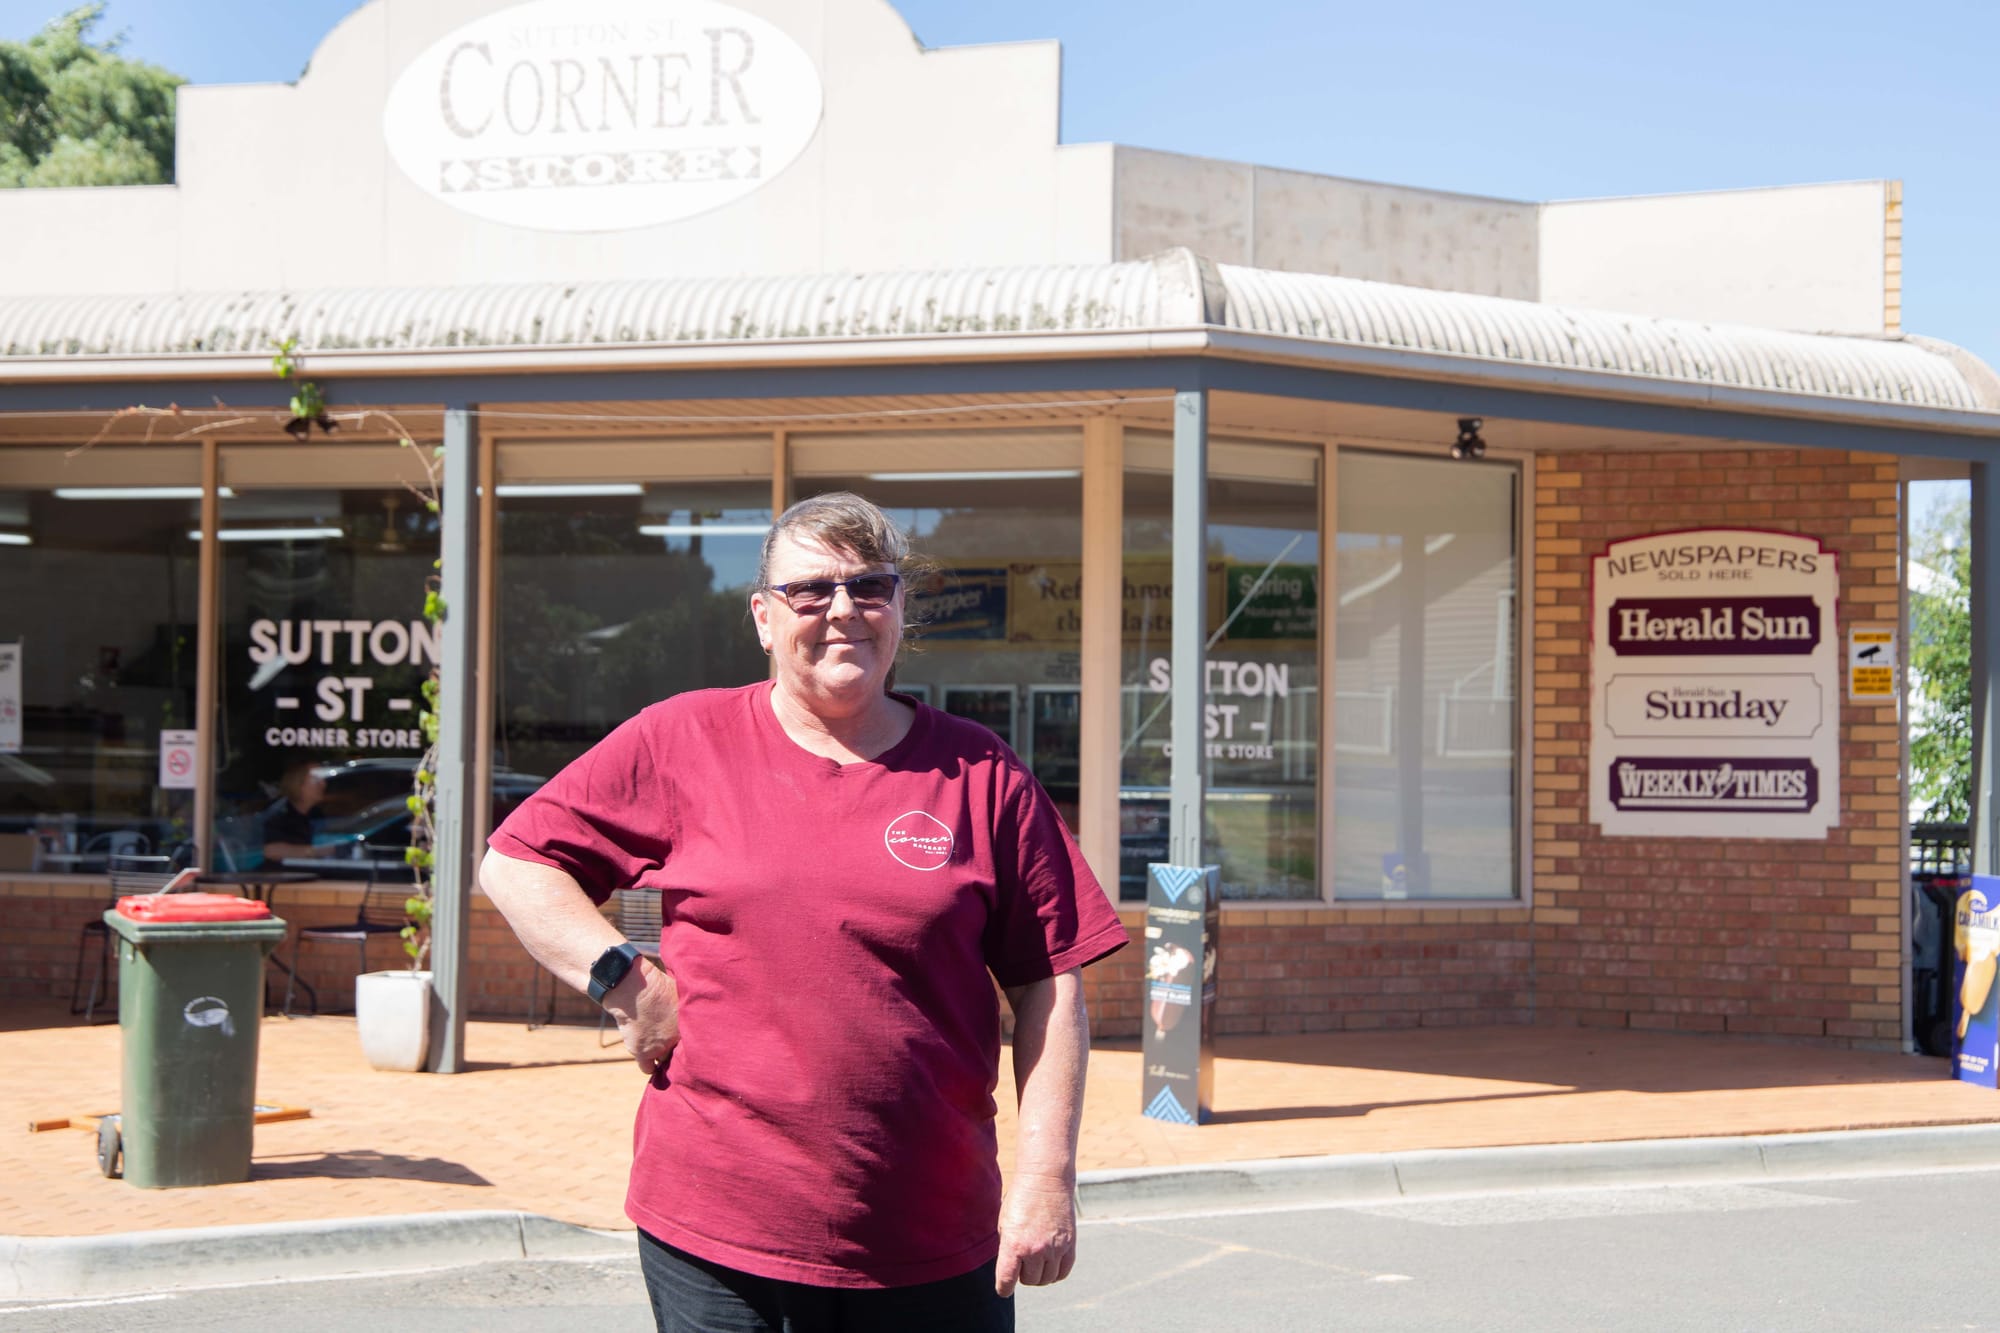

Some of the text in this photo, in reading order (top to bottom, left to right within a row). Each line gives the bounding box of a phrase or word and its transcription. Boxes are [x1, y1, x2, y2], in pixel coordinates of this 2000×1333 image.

[508, 21, 629, 50] SUTTON
[439, 27, 762, 139] CORNER
[477, 147, 721, 190] STORE
[1607, 545, 1818, 579] NEWSPAPERS
[1658, 568, 1753, 581] SOLD HERE
[1618, 606, 1812, 641] Herald Sun
[249, 619, 442, 665] SUTTON
[1149, 658, 1289, 697] STTON
[316, 677, 373, 722] ST
[1645, 690, 1789, 726] Sunday
[266, 728, 421, 748] CORNER STORE
[1228, 745, 1273, 759] STORE
[1618, 769, 1808, 798] WEEKLY TIMES
